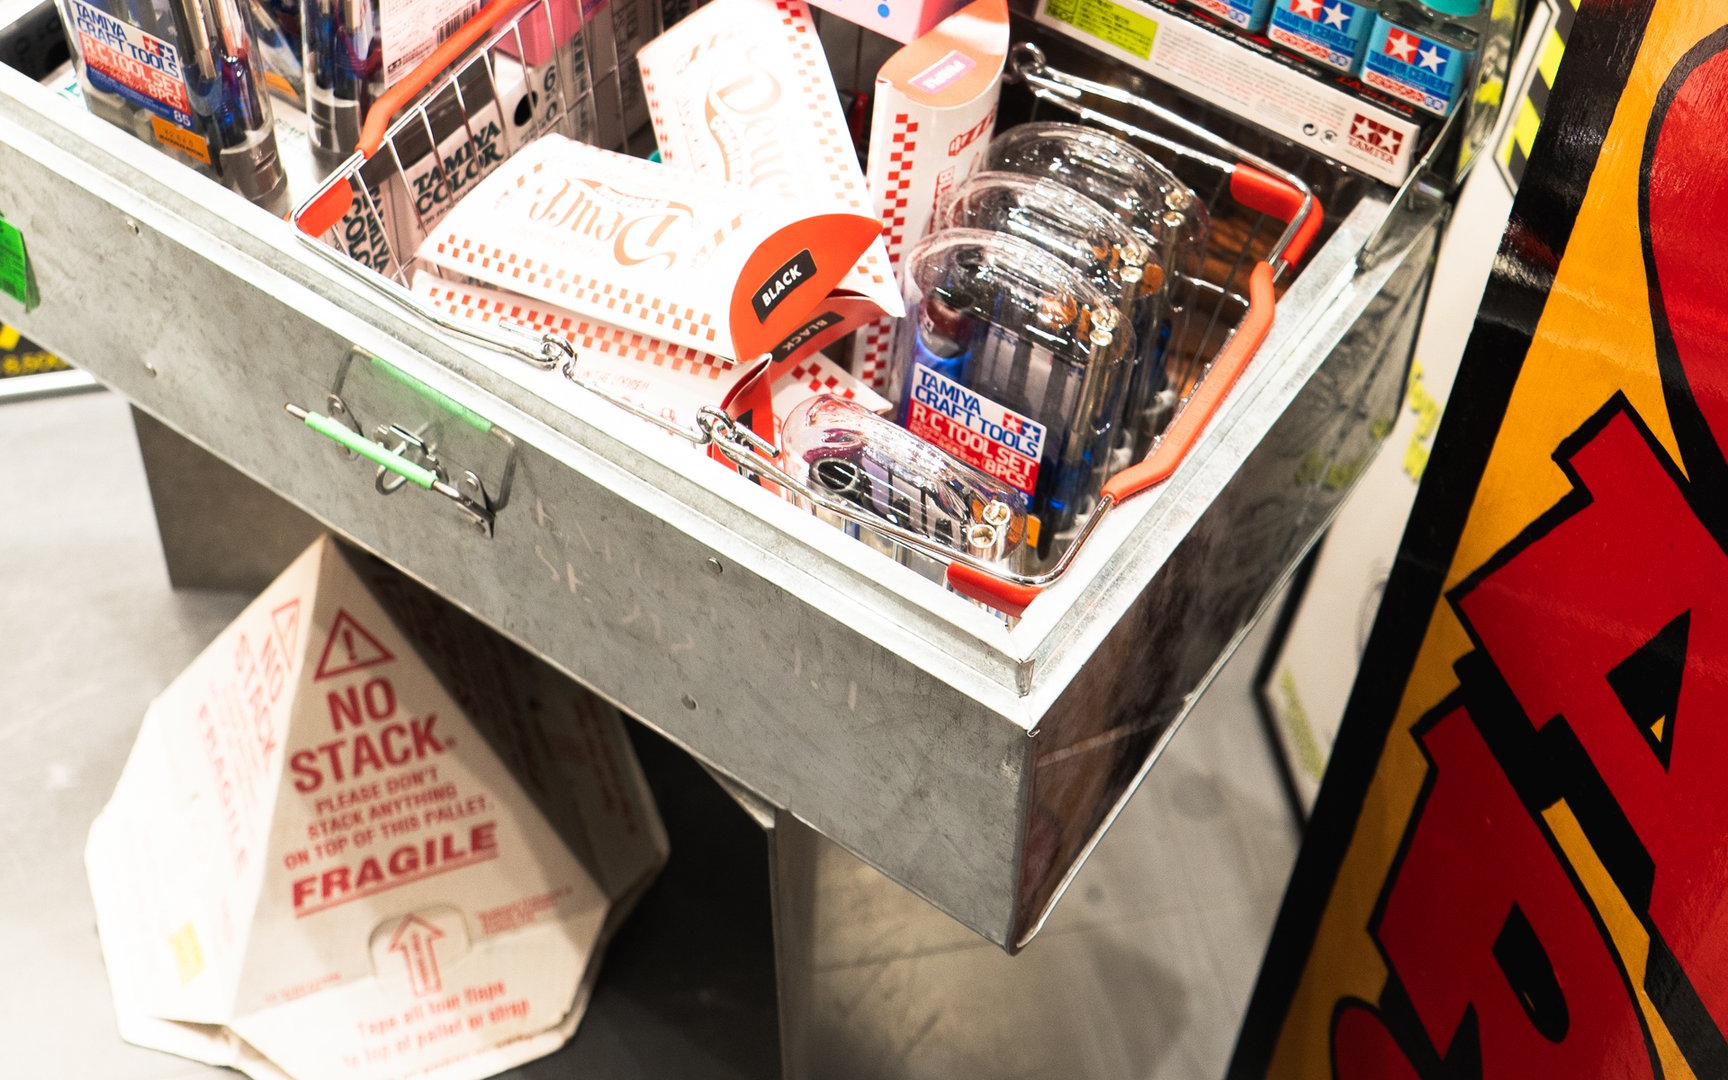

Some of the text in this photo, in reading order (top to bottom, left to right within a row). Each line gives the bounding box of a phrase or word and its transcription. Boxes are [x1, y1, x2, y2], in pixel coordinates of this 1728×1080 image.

[72, 0, 127, 40] TAMIYA
[76, 16, 124, 53] CRAFT
[125, 42, 180, 78] TOOLS
[1311, 23, 1358, 50] CEMENT
[109, 50, 152, 84] TOOL
[151, 73, 183, 97] SET
[1405, 66, 1454, 92] CEMENT
[413, 120, 501, 196] TAMIYA
[415, 141, 505, 216] COLOR
[1346, 136, 1396, 166] TAMIYA
[343, 197, 373, 273] COLO
[761, 263, 803, 308] BLACK
[781, 319, 829, 352] BLACK
[919, 368, 981, 415] TAMIYA
[914, 385, 1038, 459] CRAFT TOOLS
[943, 422, 995, 460] TOOL
[996, 445, 1037, 477] SET
[327, 676, 398, 734] NO
[307, 782, 457, 842] STACK ANYTHING
[315, 766, 439, 815] PLEASE DON'T
[283, 849, 310, 870] ON
[314, 836, 348, 860] TOP
[352, 829, 376, 848] OF
[381, 815, 421, 840] THIS
[292, 821, 499, 908] FRAGILE
